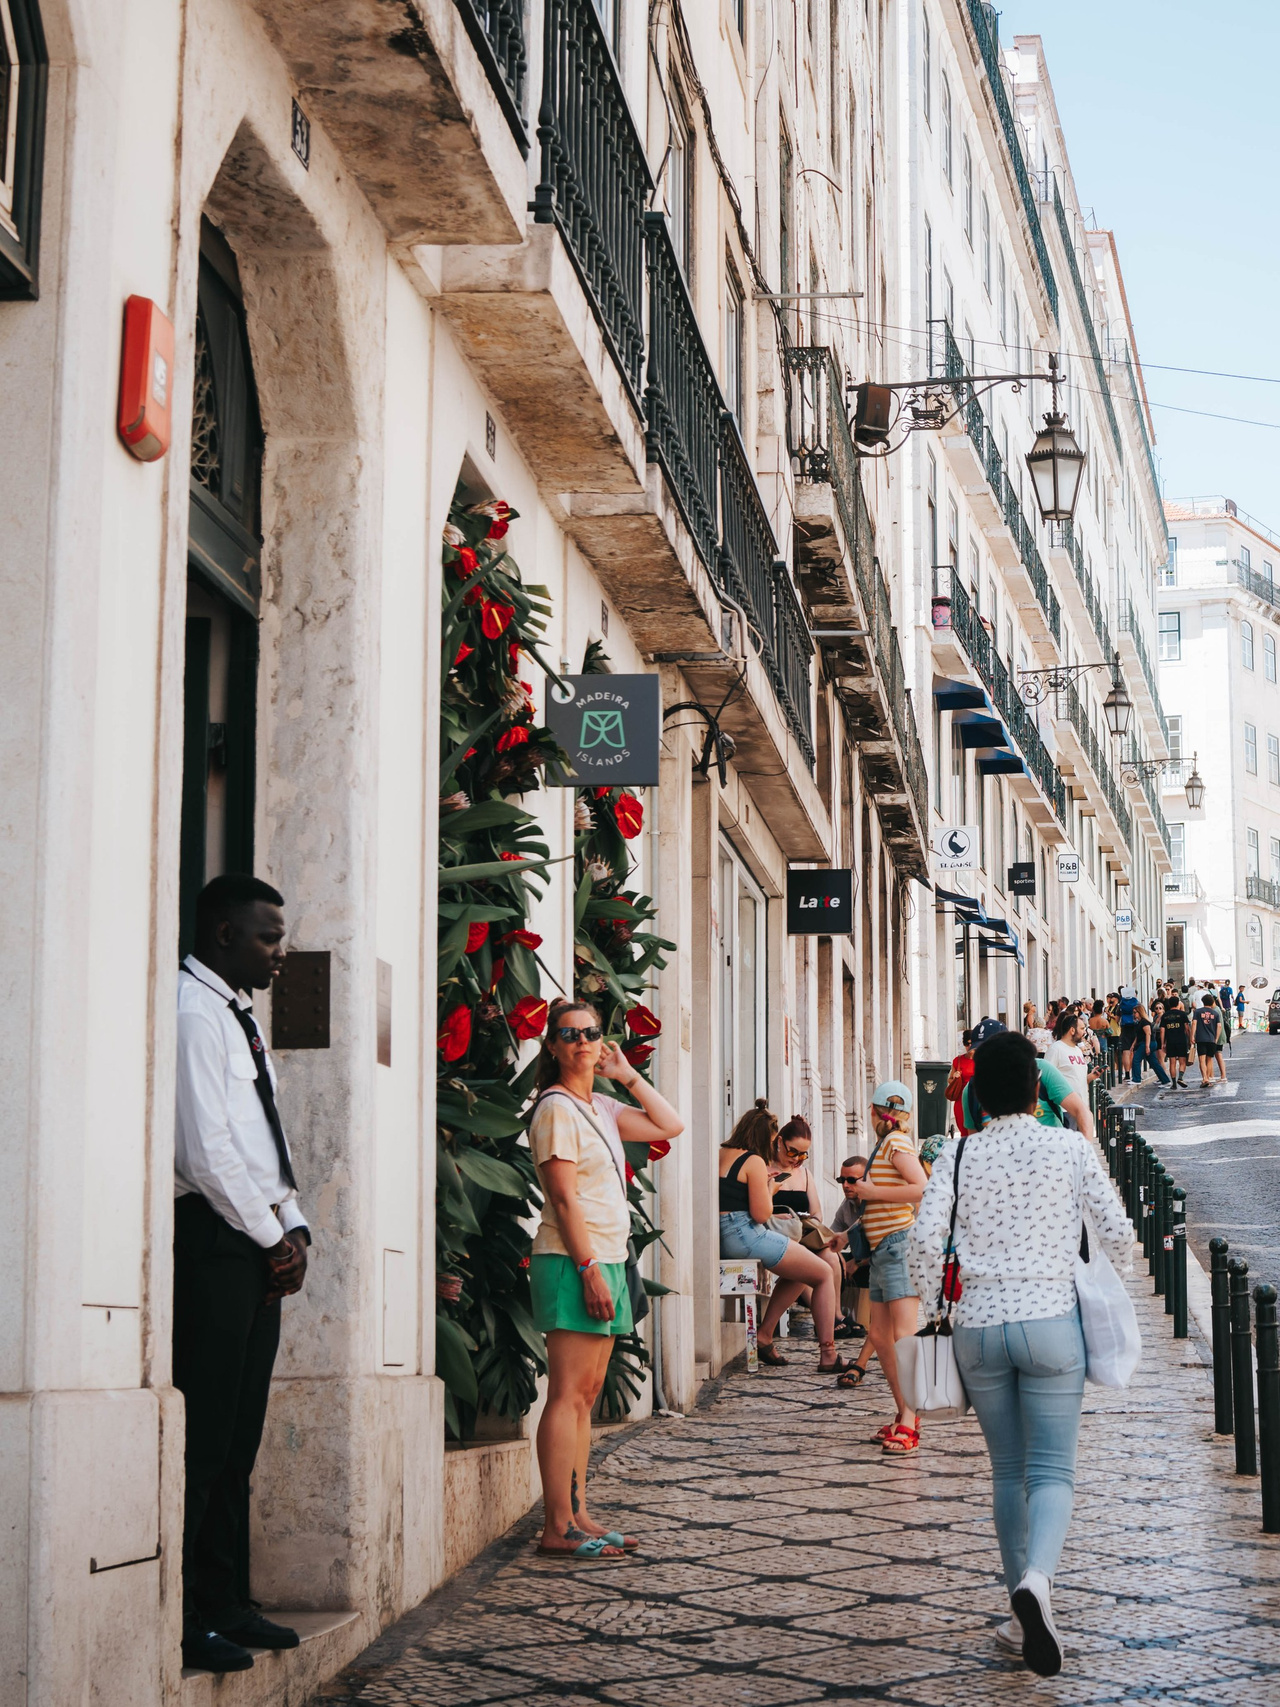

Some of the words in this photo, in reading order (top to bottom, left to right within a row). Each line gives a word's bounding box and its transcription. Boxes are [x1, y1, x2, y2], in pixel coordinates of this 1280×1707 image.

[295, 109, 307, 159] 53
[575, 692, 630, 709] MADEIRA
[576, 749, 631, 766] ISLANDS
[799, 896, 840, 908] Latte
